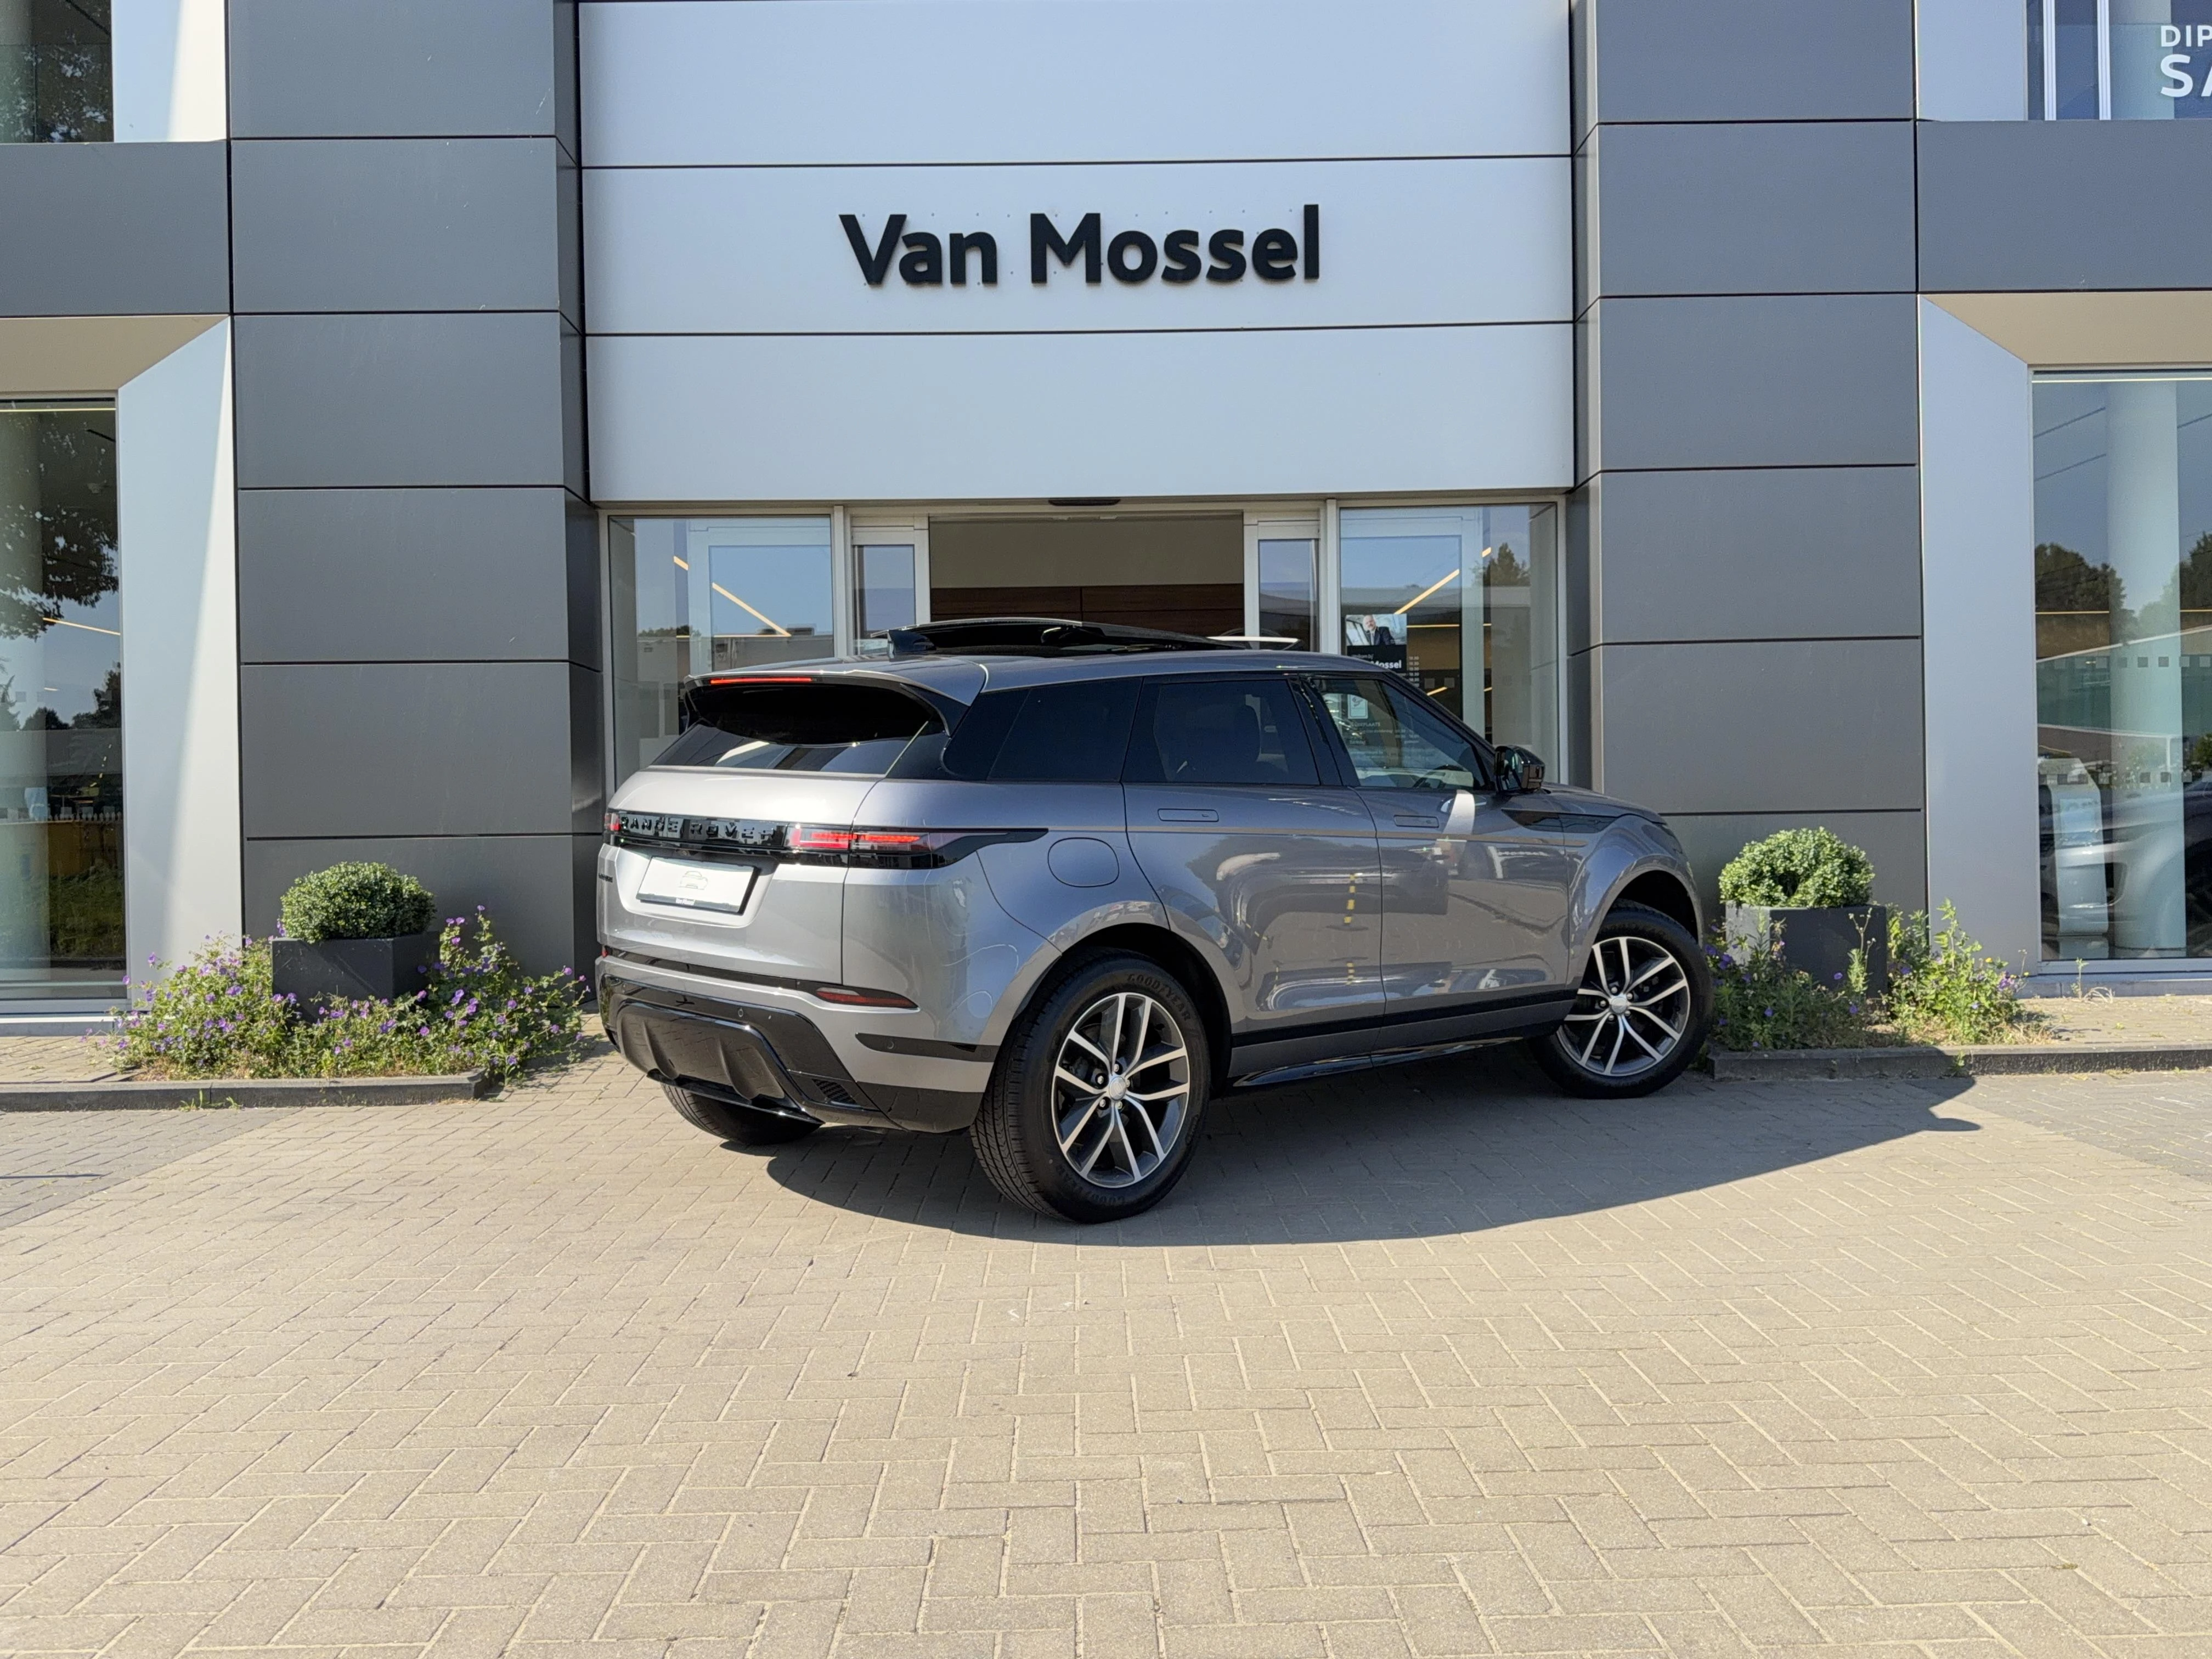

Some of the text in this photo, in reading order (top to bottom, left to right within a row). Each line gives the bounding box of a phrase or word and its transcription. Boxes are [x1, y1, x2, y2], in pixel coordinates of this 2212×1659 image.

[2160, 54, 2212, 97] S
[838, 204, 1319, 285] Van Mossel
[620, 816, 776, 842] RANGE ROVER
[1126, 973, 1191, 1022] GOODYEAR
